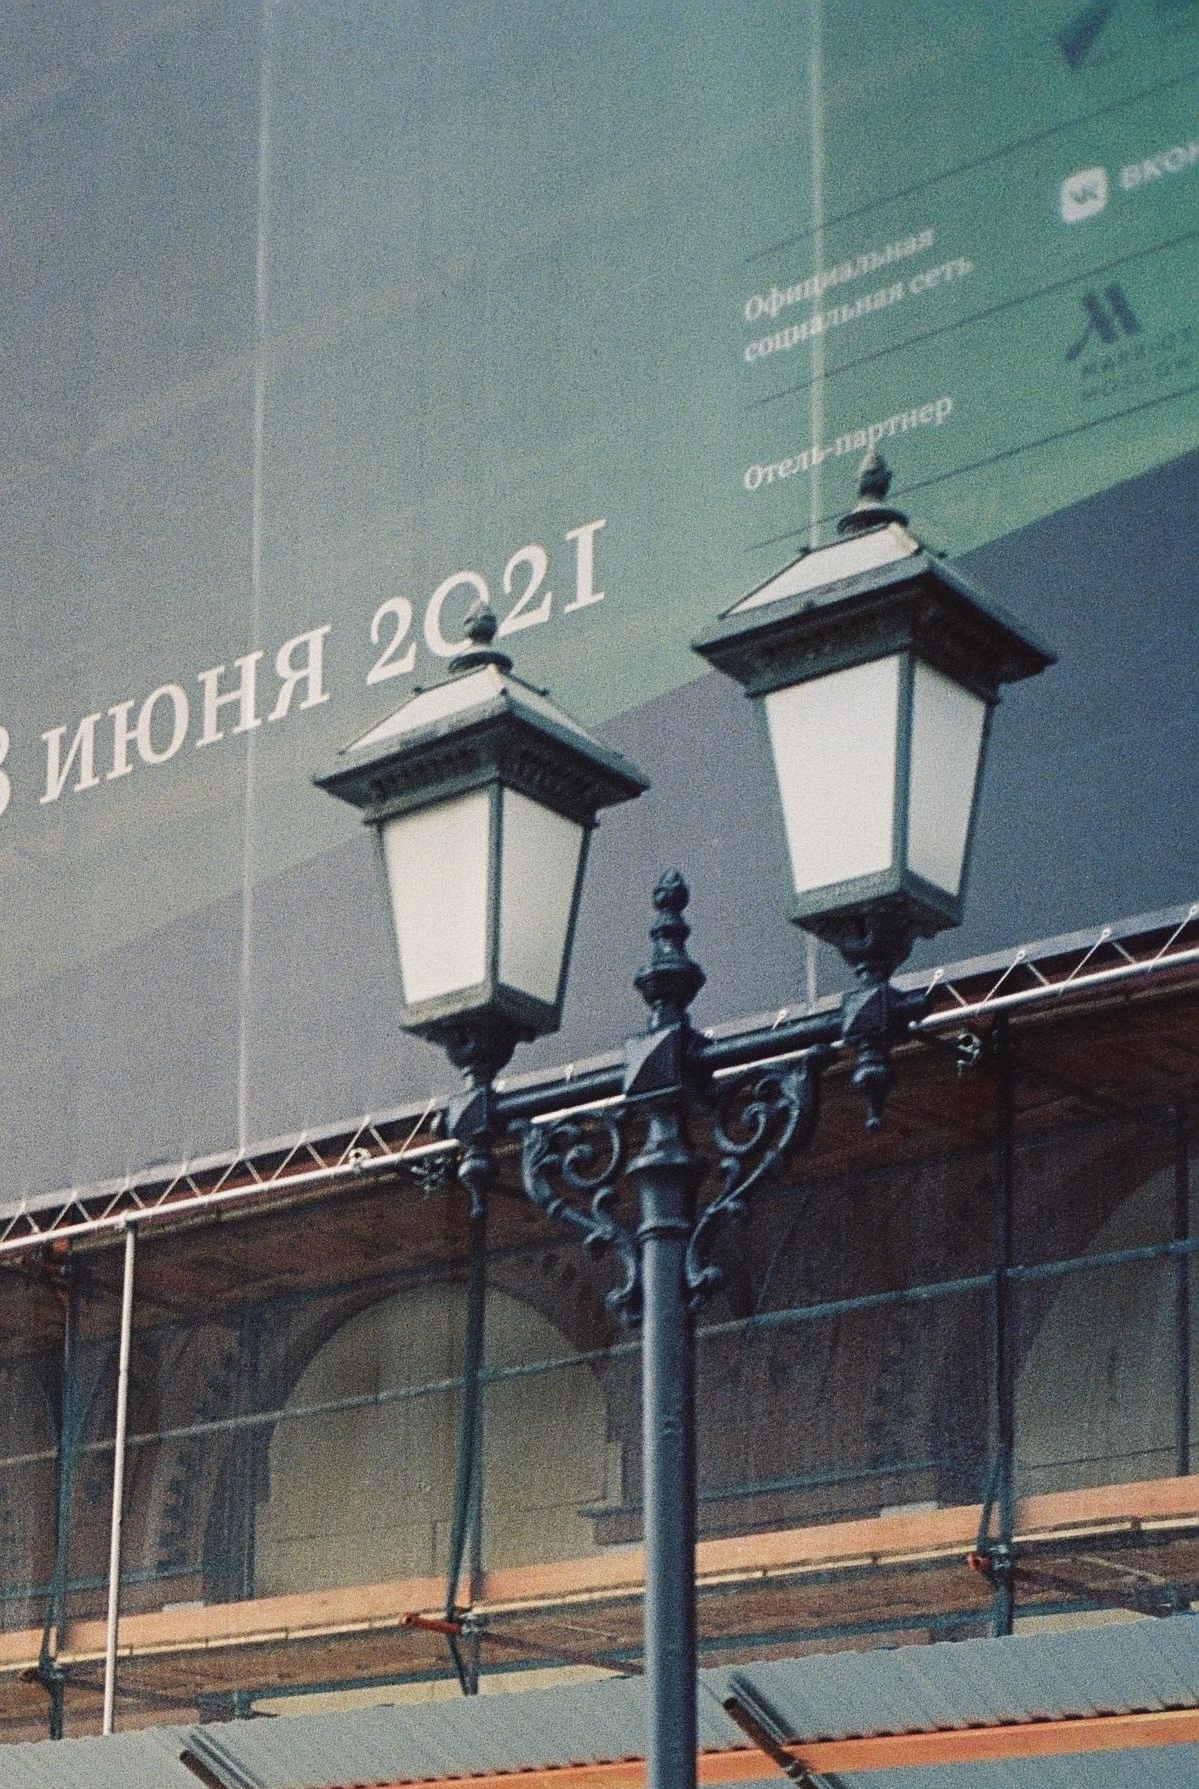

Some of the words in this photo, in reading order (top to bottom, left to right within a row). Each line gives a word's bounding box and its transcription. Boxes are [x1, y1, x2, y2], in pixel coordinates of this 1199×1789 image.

[743, 228, 935, 321] Официальная
[744, 281, 905, 362] социальная
[909, 255, 976, 294] сеть
[743, 395, 954, 492] Отель-партнер
[38, 625, 332, 804] июня
[365, 519, 607, 685] 2021
